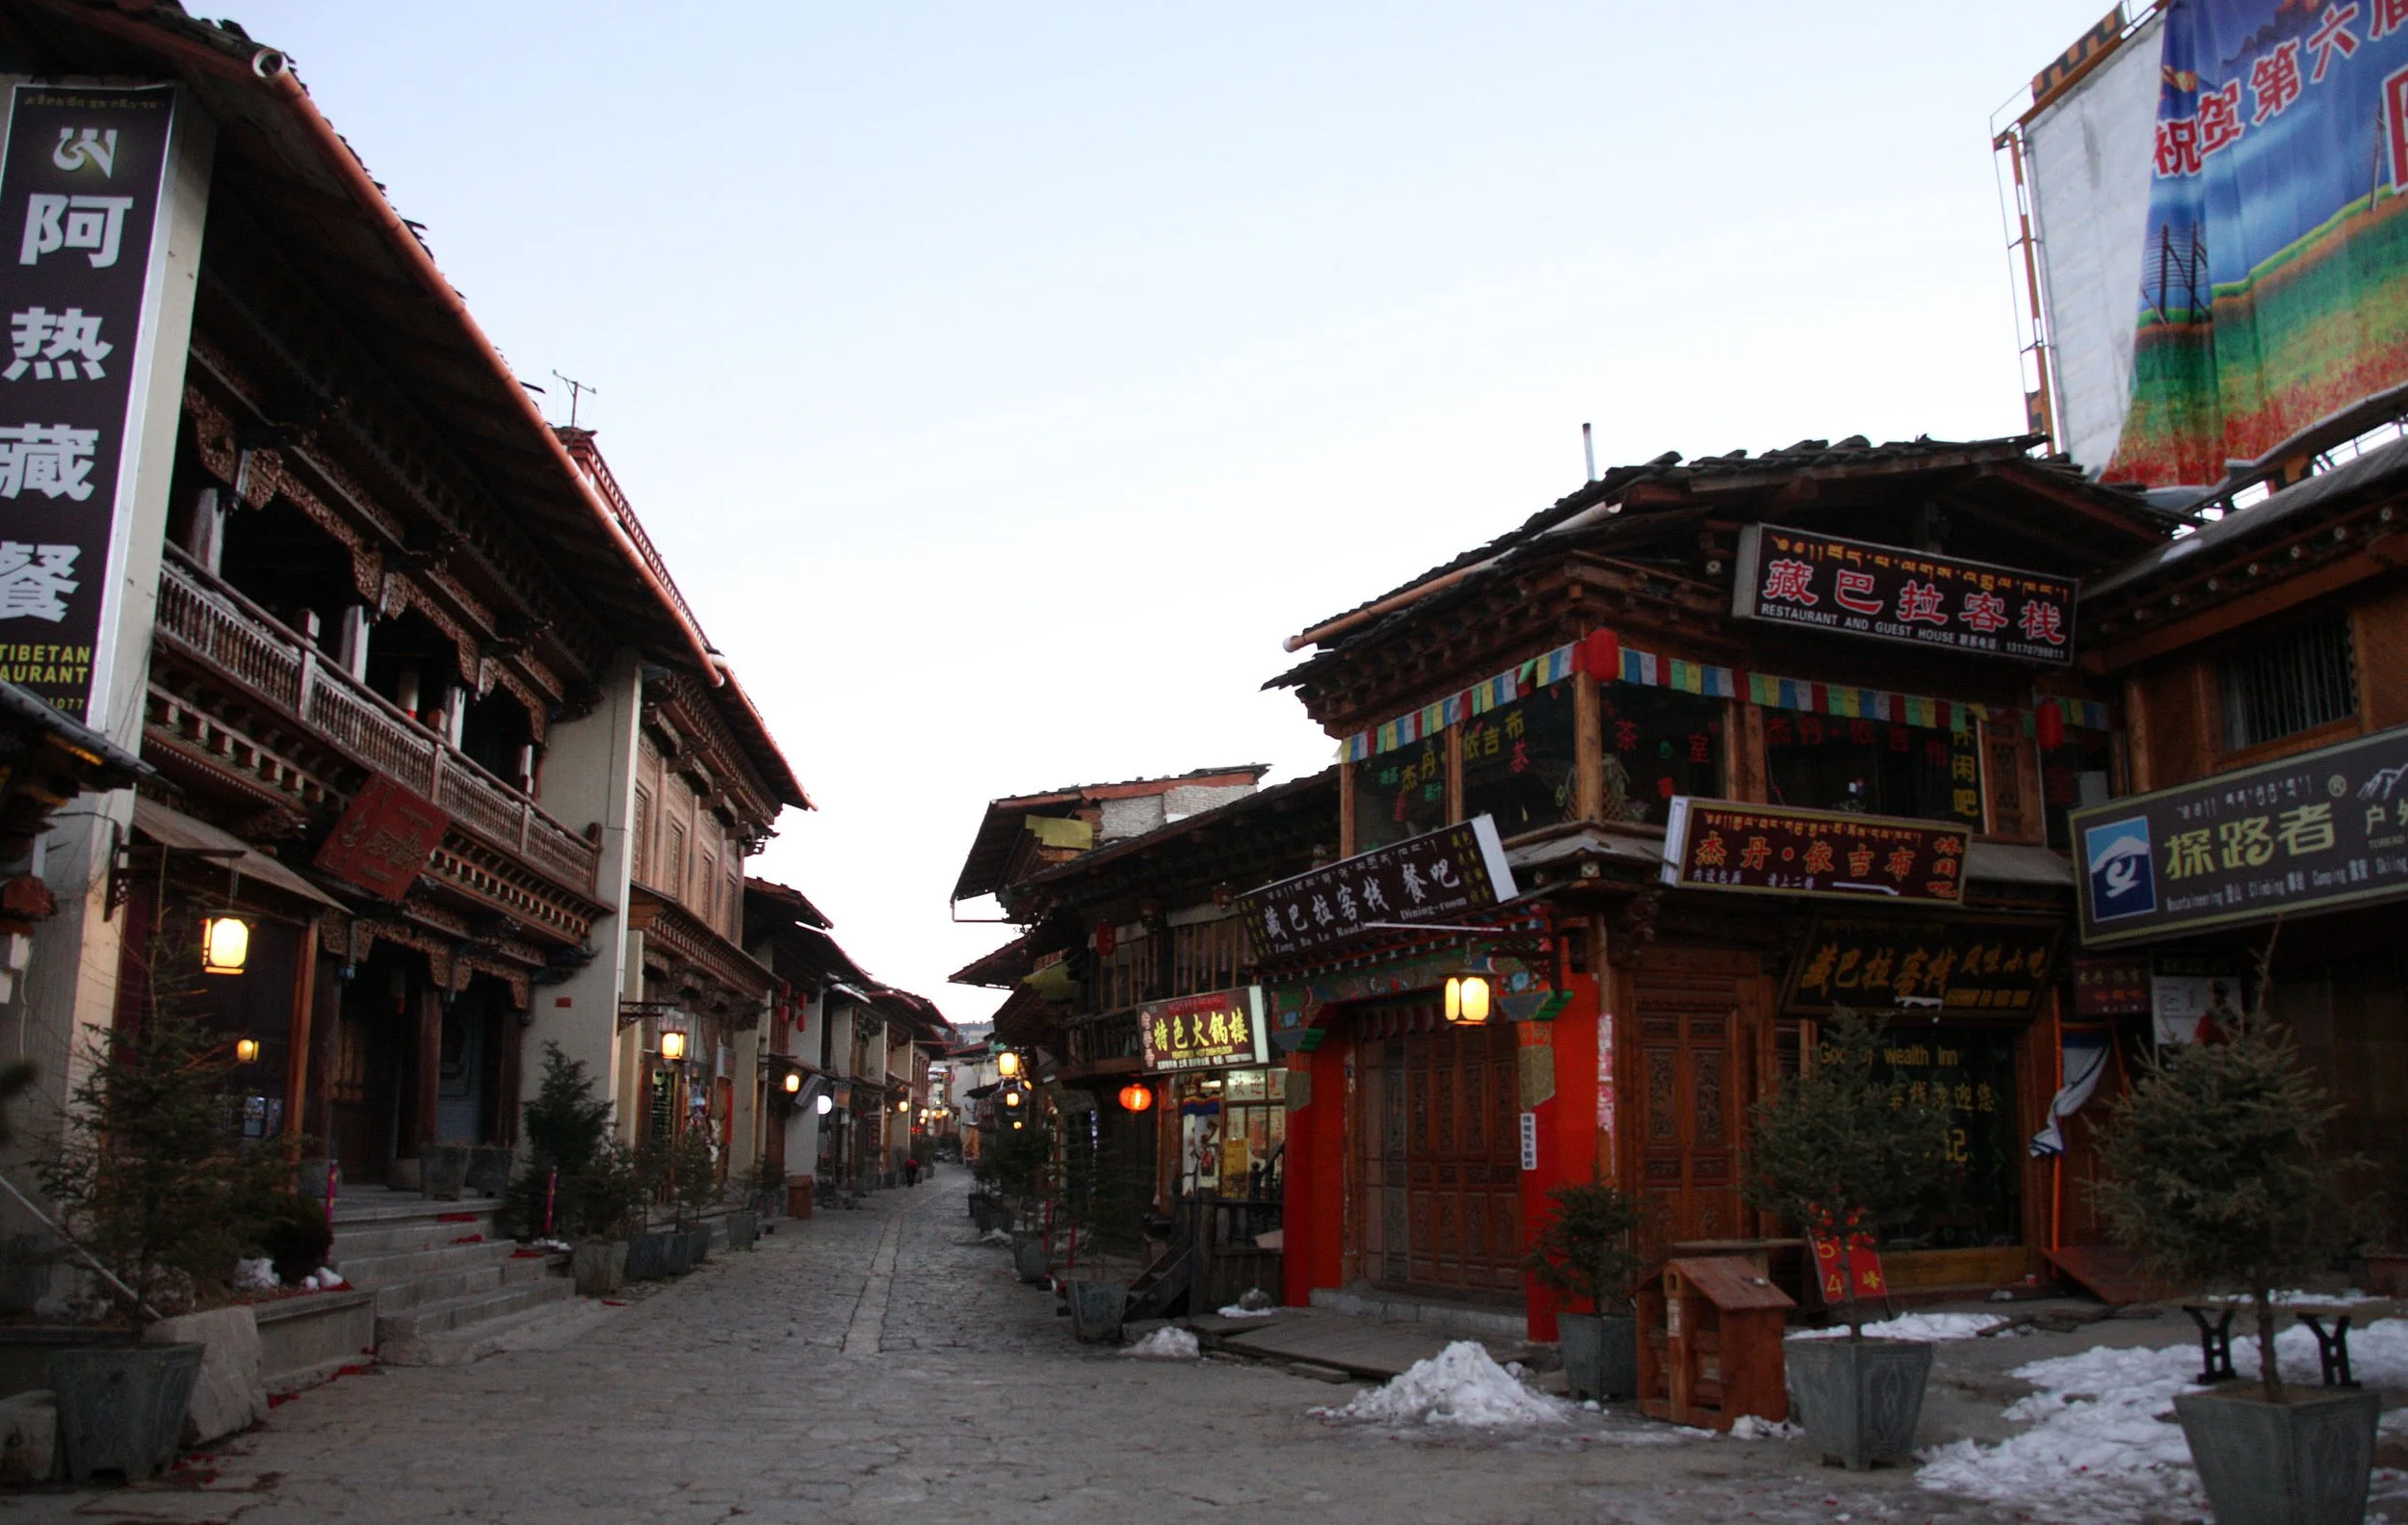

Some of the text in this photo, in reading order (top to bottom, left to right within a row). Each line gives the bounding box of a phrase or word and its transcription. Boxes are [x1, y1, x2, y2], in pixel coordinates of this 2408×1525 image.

[0, 194, 133, 623] 阿热藏餐
[1761, 602, 1955, 644] RESTAURANT AND GUEST HOUSE
[1763, 559, 2066, 644] 藏巴拉客栈
[0, 644, 91, 664] TIBETAN
[0, 664, 88, 685] AURANT
[2164, 801, 2335, 881] 探路者
